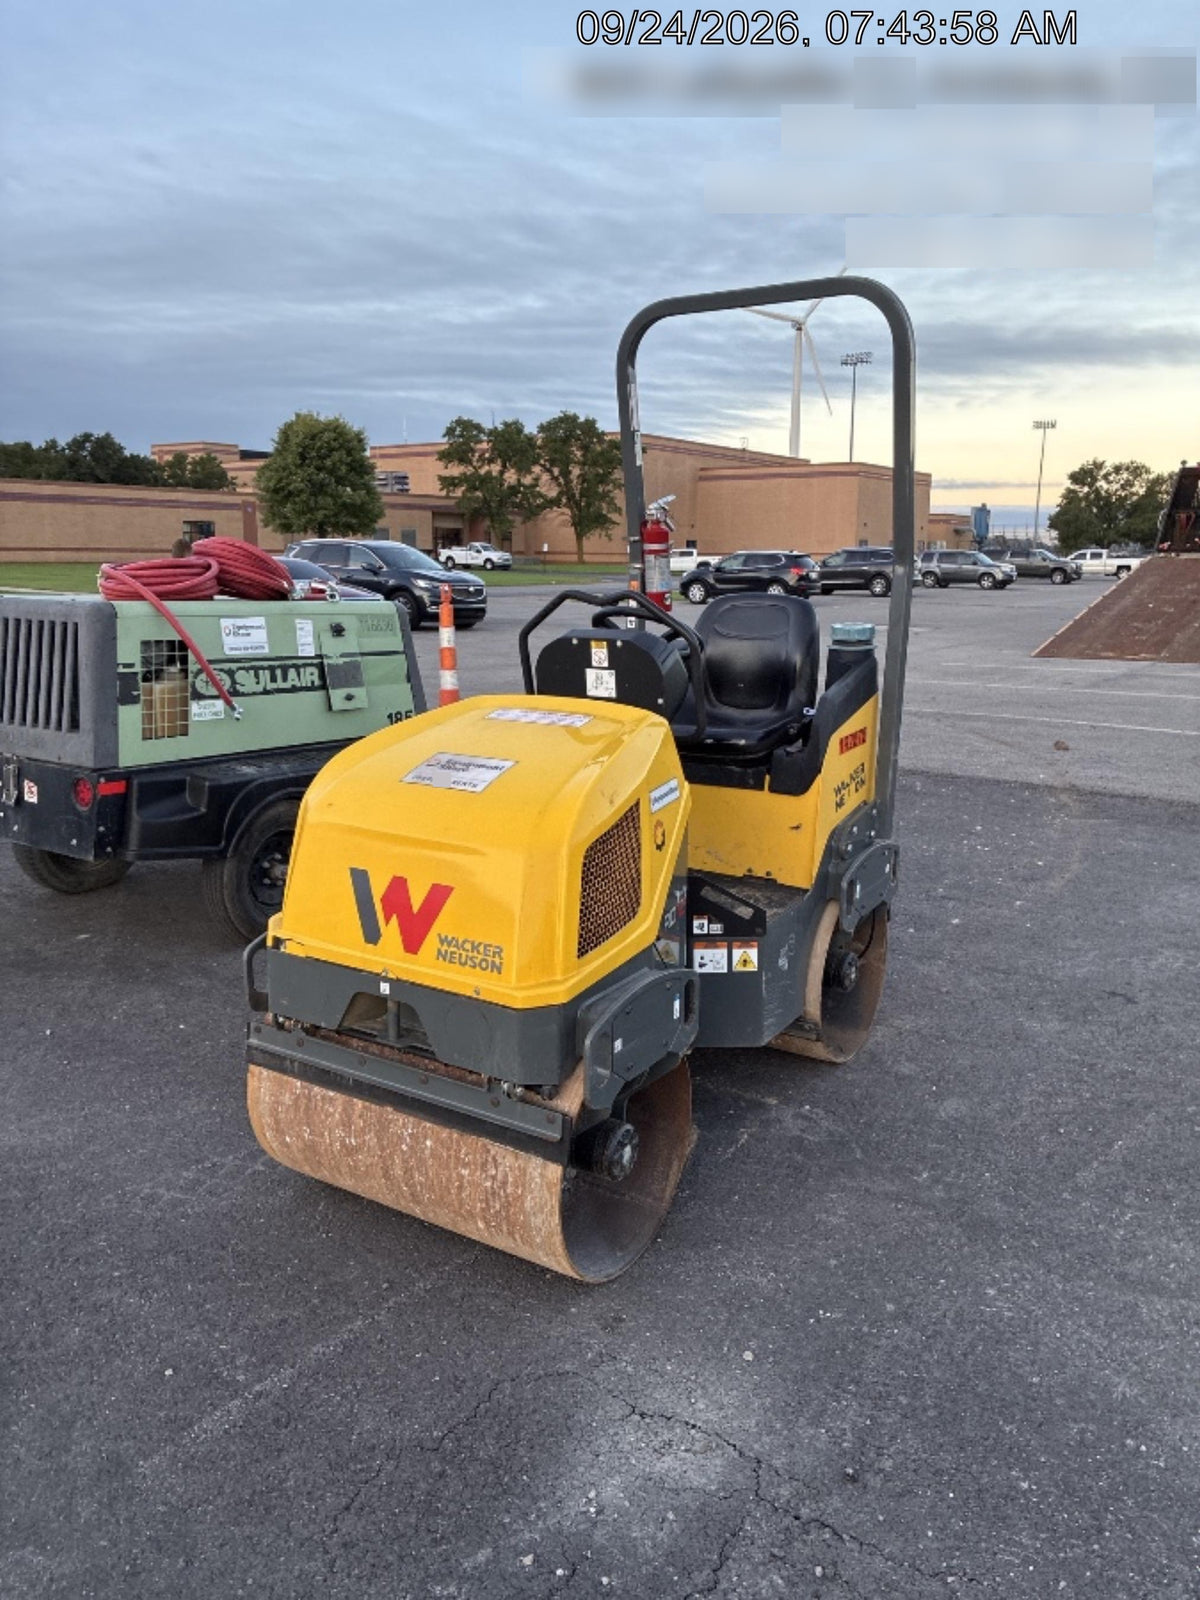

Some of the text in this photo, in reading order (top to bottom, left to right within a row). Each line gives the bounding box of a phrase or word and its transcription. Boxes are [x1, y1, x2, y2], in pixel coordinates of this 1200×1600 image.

[234, 666, 321, 693] SULLAIR
[437, 933, 504, 960] WACKER
[436, 948, 504, 975] NEUSON
